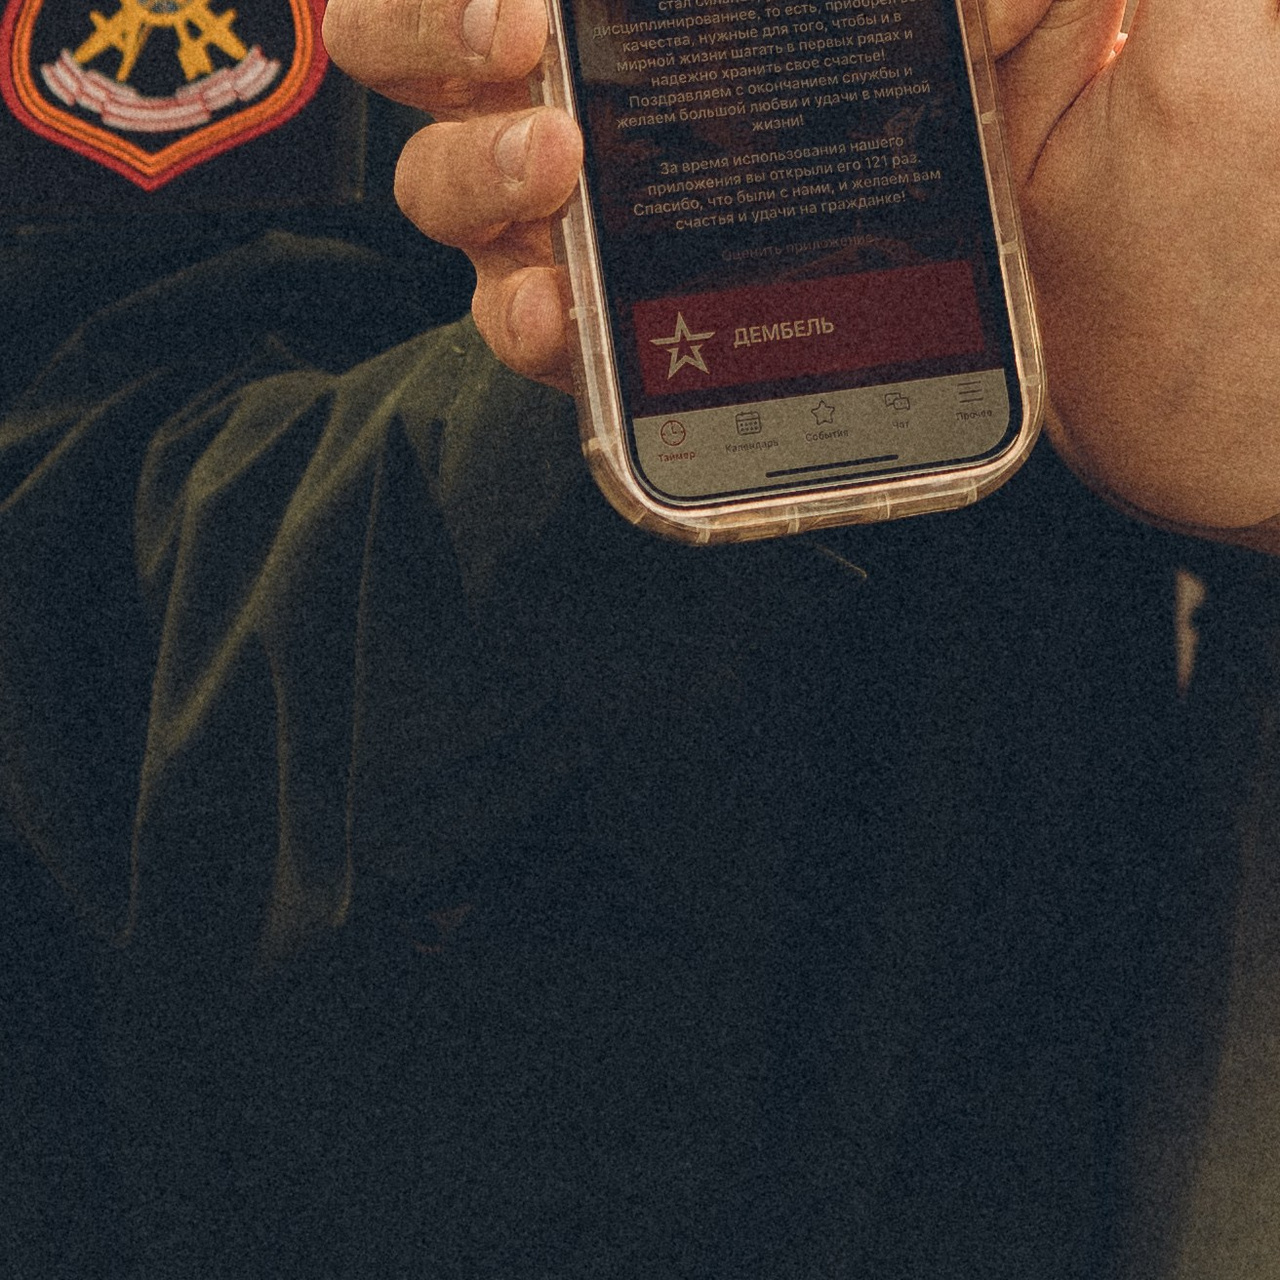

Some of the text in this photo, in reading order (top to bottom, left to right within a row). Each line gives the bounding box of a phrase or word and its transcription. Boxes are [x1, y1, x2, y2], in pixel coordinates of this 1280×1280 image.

[592, 9, 761, 39] дисциплинированнее,
[765, 6, 781, 18] то
[784, 3, 821, 15] есть,
[622, 12, 902, 53] качества, нужные для того, чтобы и в
[616, 29, 913, 72] мирной жизни шагать в первых рядах и
[651, 49, 886, 87] надежно хранить свое счастье!
[616, 80, 931, 130] желаем большой любви и удачи в мирной
[629, 66, 913, 108] Поздравляем с окончанием службы и
[752, 114, 805, 132] жизни!
[660, 137, 904, 175] За время использования нашего
[633, 169, 941, 217] Спасибо, что были с нами, и желаем вам
[648, 154, 921, 197] приложения вы открыли его 121 раз.
[675, 191, 906, 230] счастья и удачи на гражданке!
[721, 233, 876, 262] Оценить приложение
[733, 316, 835, 349] ДЕМБЕЛЬ
[725, 439, 779, 454] Календарь
[805, 428, 849, 443] События
[657, 451, 696, 463] Таймер
